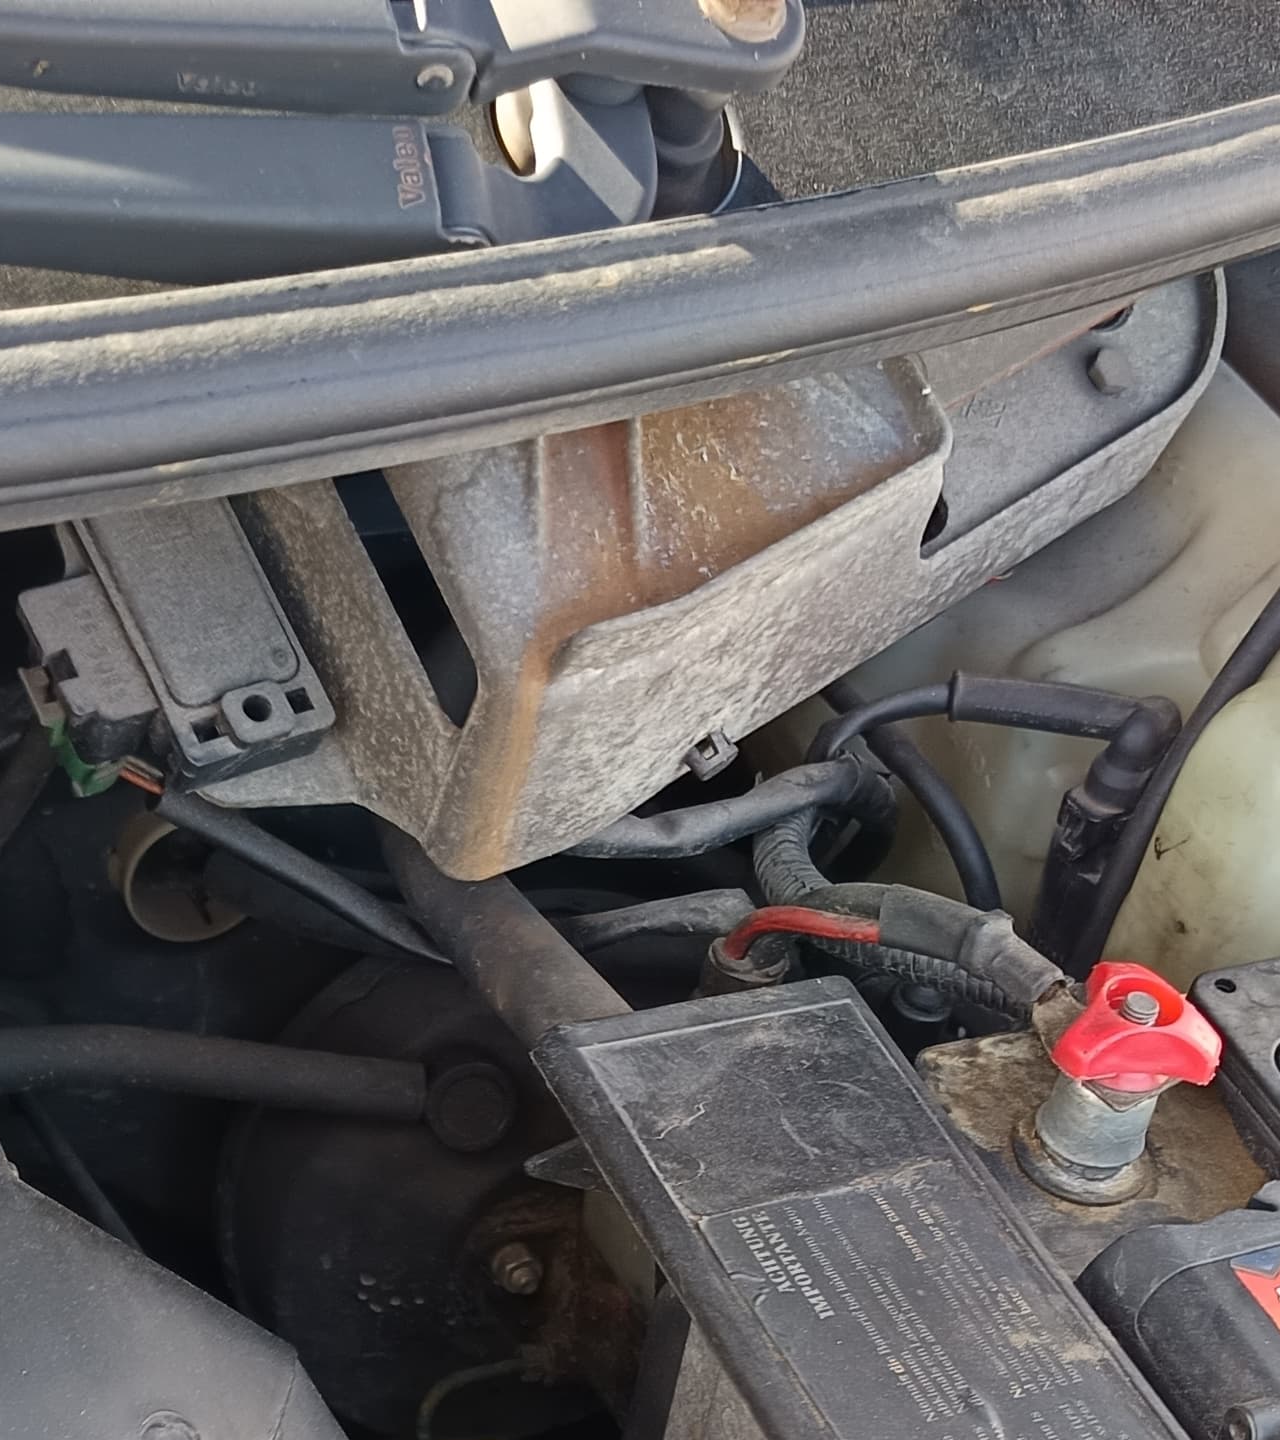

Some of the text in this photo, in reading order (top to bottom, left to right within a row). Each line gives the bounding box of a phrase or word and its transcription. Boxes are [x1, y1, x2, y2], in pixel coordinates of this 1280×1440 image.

[729, 1215, 796, 1294] ACHTUNG
[749, 1210, 837, 1318] IMPORTANTE
[850, 1310, 892, 1355] Batterie
[1002, 1380, 1026, 1399] No
[1025, 1410, 1044, 1422] is
[1055, 1403, 1085, 1430] first
[1069, 1399, 1107, 1436] wires
